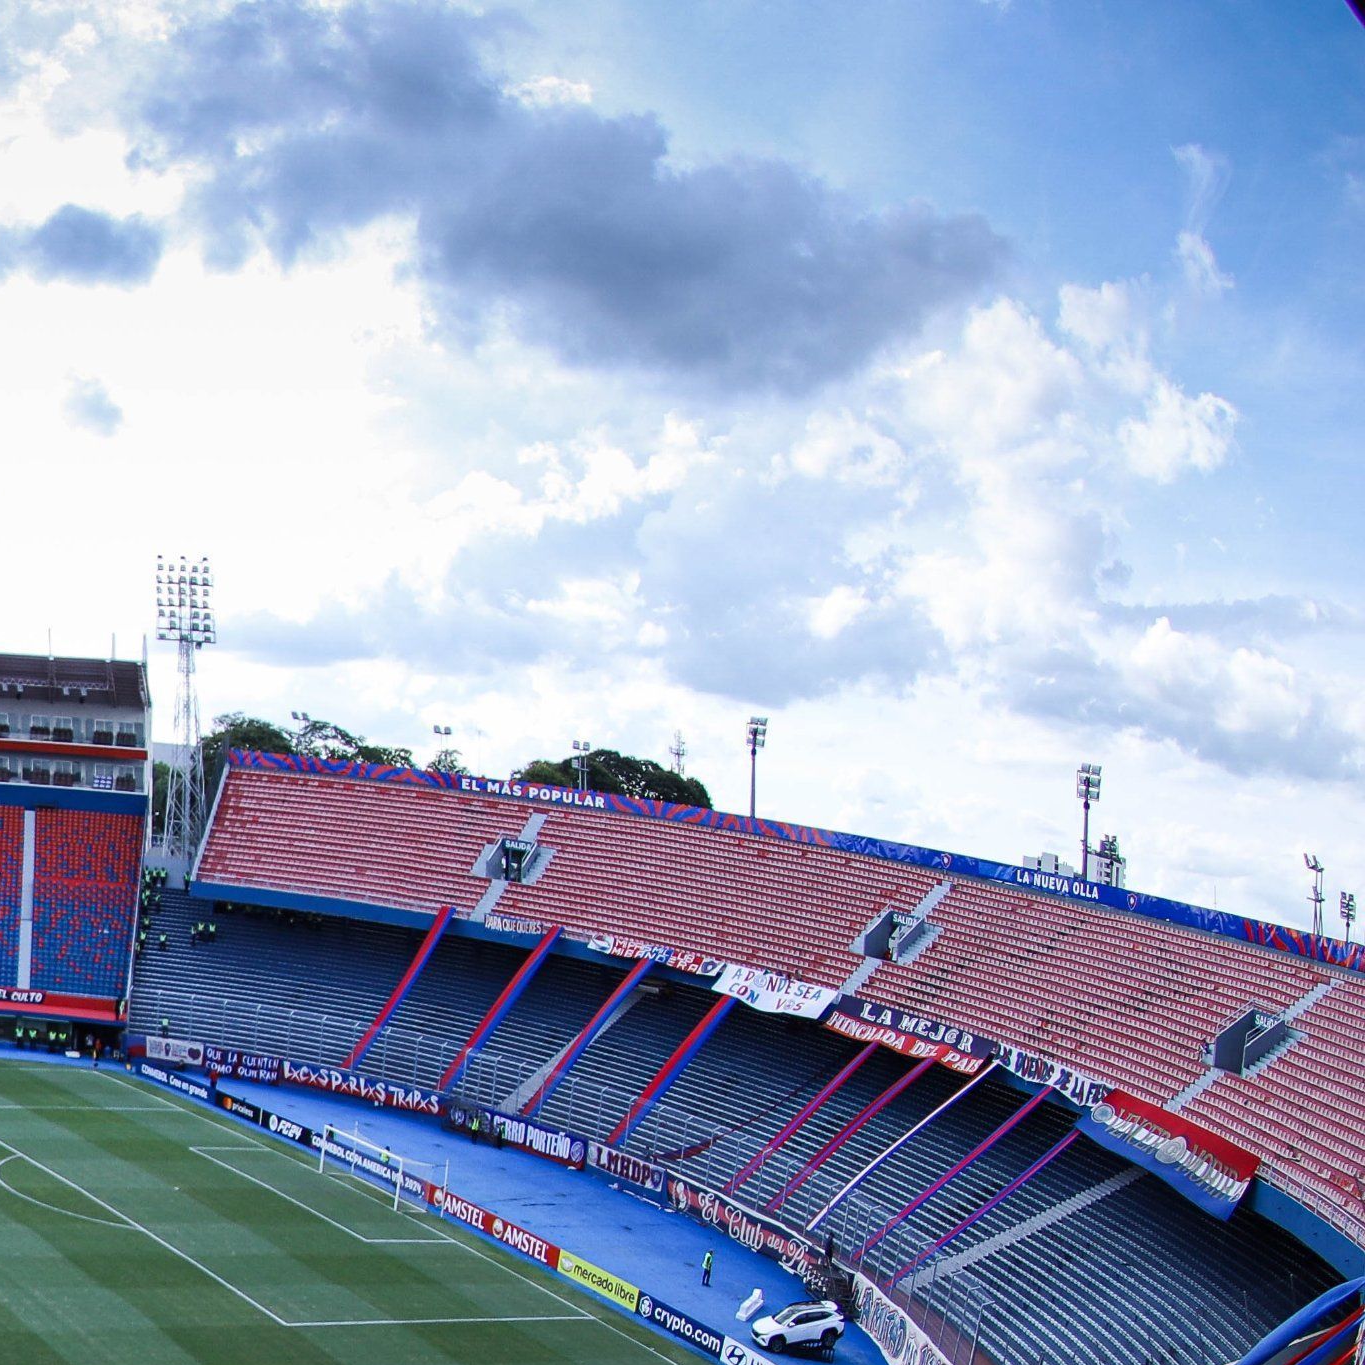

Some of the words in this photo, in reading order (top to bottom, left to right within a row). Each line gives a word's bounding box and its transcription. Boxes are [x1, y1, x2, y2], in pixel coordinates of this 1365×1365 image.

[461, 778, 480, 792] EL
[487, 780, 522, 796] MÁS
[529, 786, 605, 808] POPULAR
[506, 841, 532, 851] SALIDA
[1016, 870, 1030, 884] LA
[1033, 873, 1069, 894] NUEVA
[1072, 882, 1099, 900] OLLA
[484, 915, 503, 932] PARA
[11, 991, 43, 1003] CULTO
[729, 982, 760, 1004] CON
[732, 968, 742, 980] A
[794, 984, 822, 1002] SEA
[859, 1002, 892, 1026] LA
[826, 1011, 906, 1050] HINCHADA
[909, 1039, 938, 1057] DEL
[206, 1061, 232, 1075] COMO
[228, 1050, 238, 1063] LA
[232, 1101, 254, 1118] priceless
[526, 1124, 571, 1160] PORTEÑO
[597, 1147, 653, 1186] LMHDP
[443, 1194, 485, 1230] AMSTEL
[698, 1192, 720, 1224] El
[725, 1205, 764, 1249] Club
[766, 1233, 785, 1254] del
[503, 1226, 548, 1263] AMSTEL
[573, 1264, 614, 1291] mercado
[614, 1282, 636, 1303] libre
[654, 1306, 721, 1353] crypto.com
